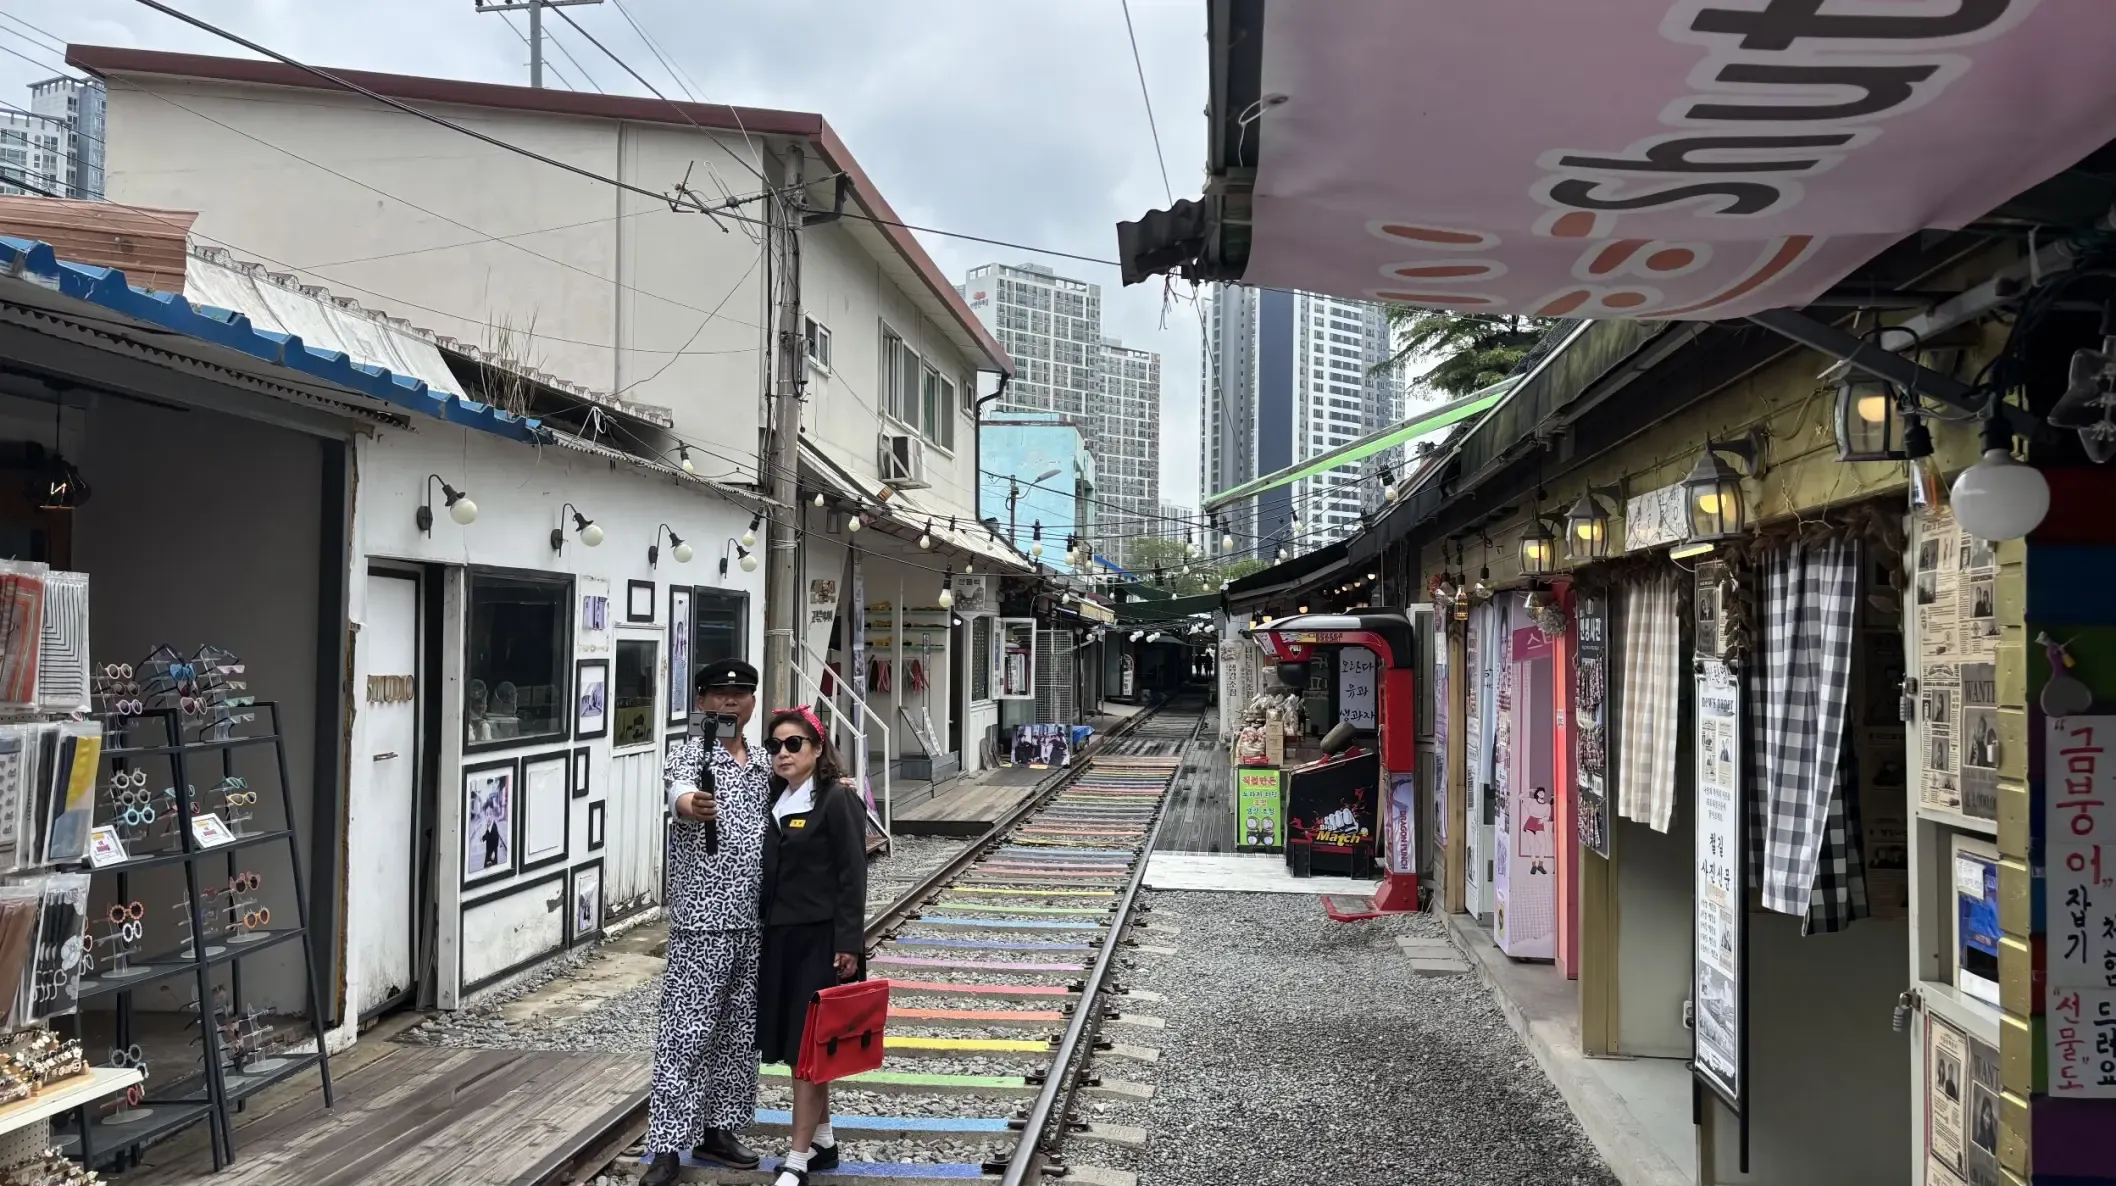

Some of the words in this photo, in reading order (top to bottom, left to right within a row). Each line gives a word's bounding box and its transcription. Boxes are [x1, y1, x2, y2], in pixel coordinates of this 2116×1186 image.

[1341, 659, 1374, 674] 오란다
[366, 674, 414, 703] STUDIO
[1345, 683, 1369, 699] 유과
[1340, 708, 1376, 722] 생과자
[1400, 810, 1408, 842] DRAGON
[1316, 831, 1360, 847] Match
[1700, 858, 1731, 892] 사진신문
[2064, 884, 2093, 963] 잡기
